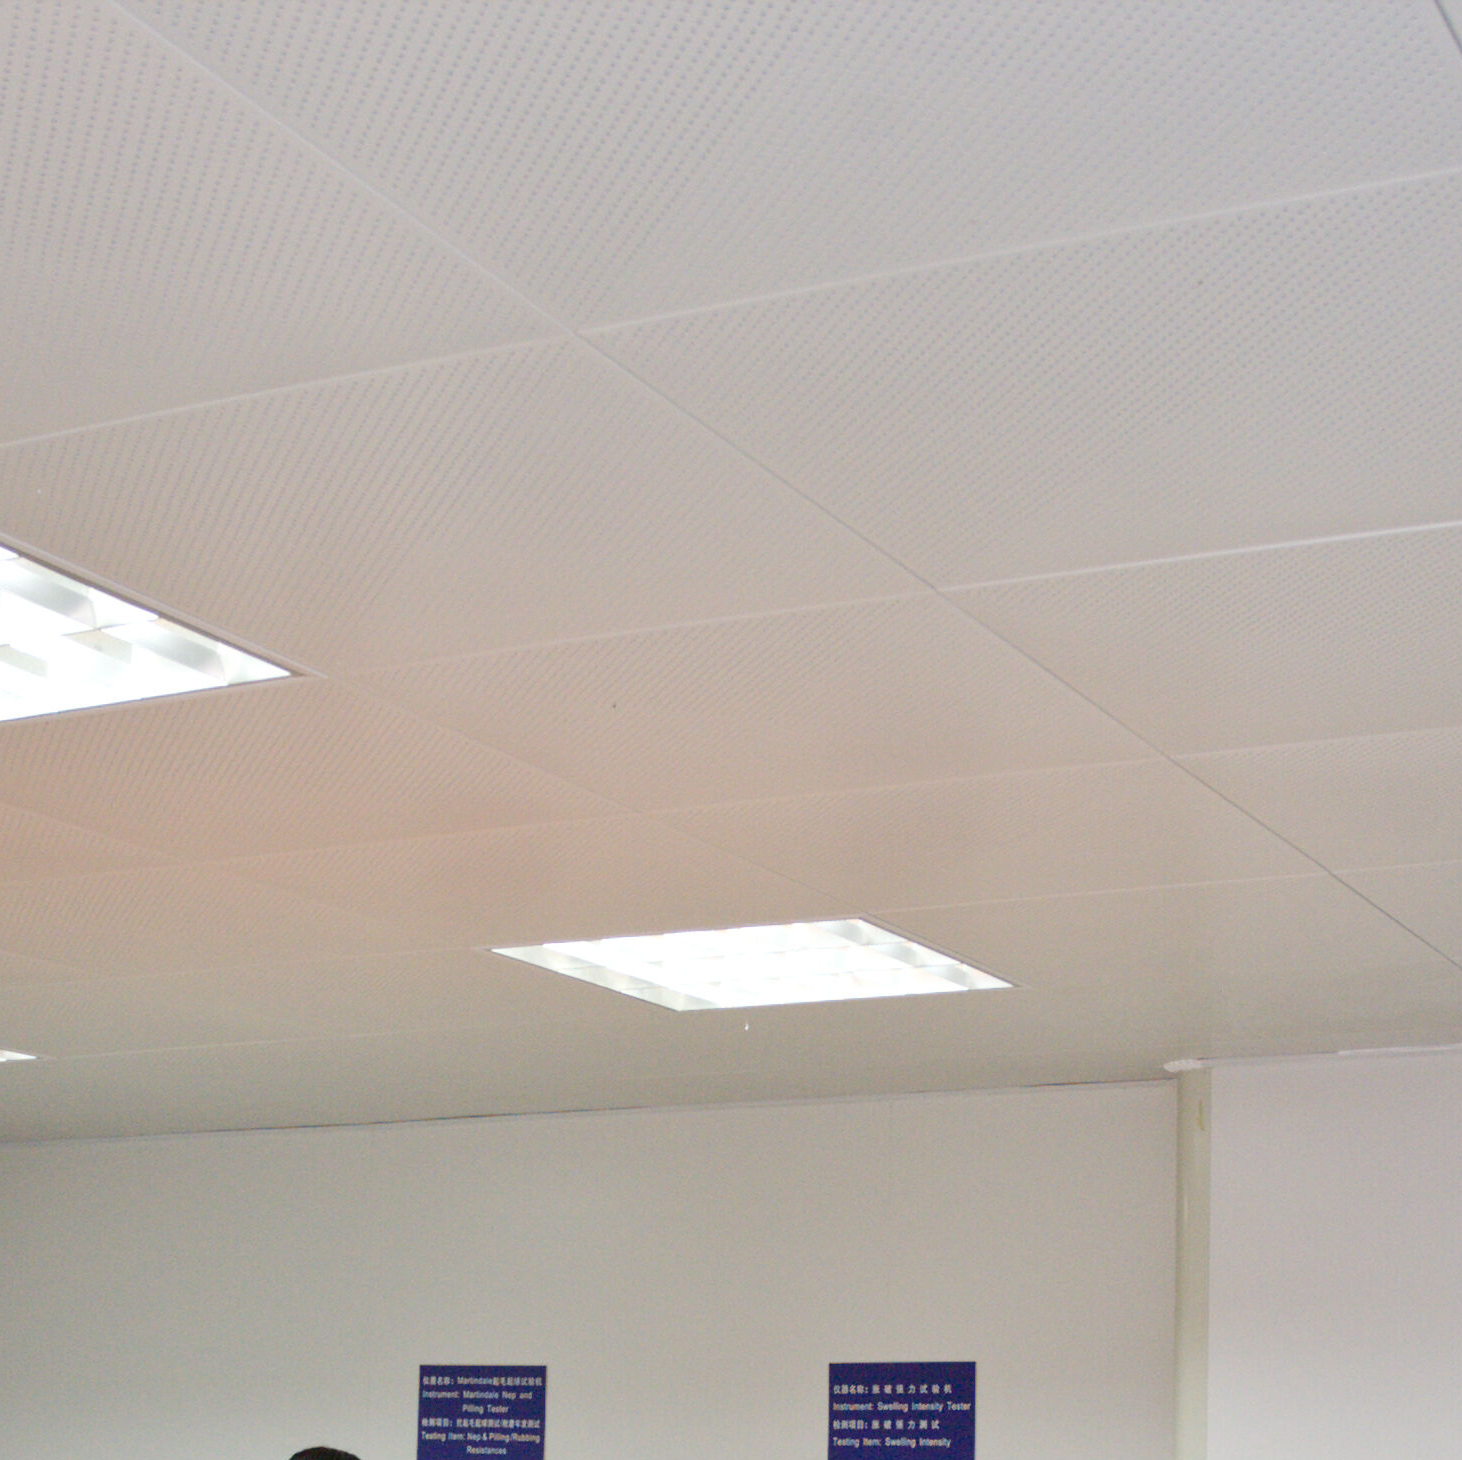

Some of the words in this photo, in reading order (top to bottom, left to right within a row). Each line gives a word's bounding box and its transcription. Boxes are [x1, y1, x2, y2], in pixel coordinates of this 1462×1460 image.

[422, 1390, 460, 1399] Instrument:
[462, 1390, 499, 1399] Martindale
[519, 1391, 533, 1399] and
[462, 1404, 484, 1414] Pilling
[487, 1404, 509, 1414] Tester
[833, 1402, 874, 1411] Instrument:
[877, 1402, 909, 1413] Swelling
[912, 1402, 944, 1412] Intensity
[947, 1401, 971, 1411] Tester
[421, 1431, 447, 1442] Testing
[833, 1437, 860, 1448] Testing
[885, 1437, 917, 1448] Swelling
[919, 1438, 951, 1448] Intensity
